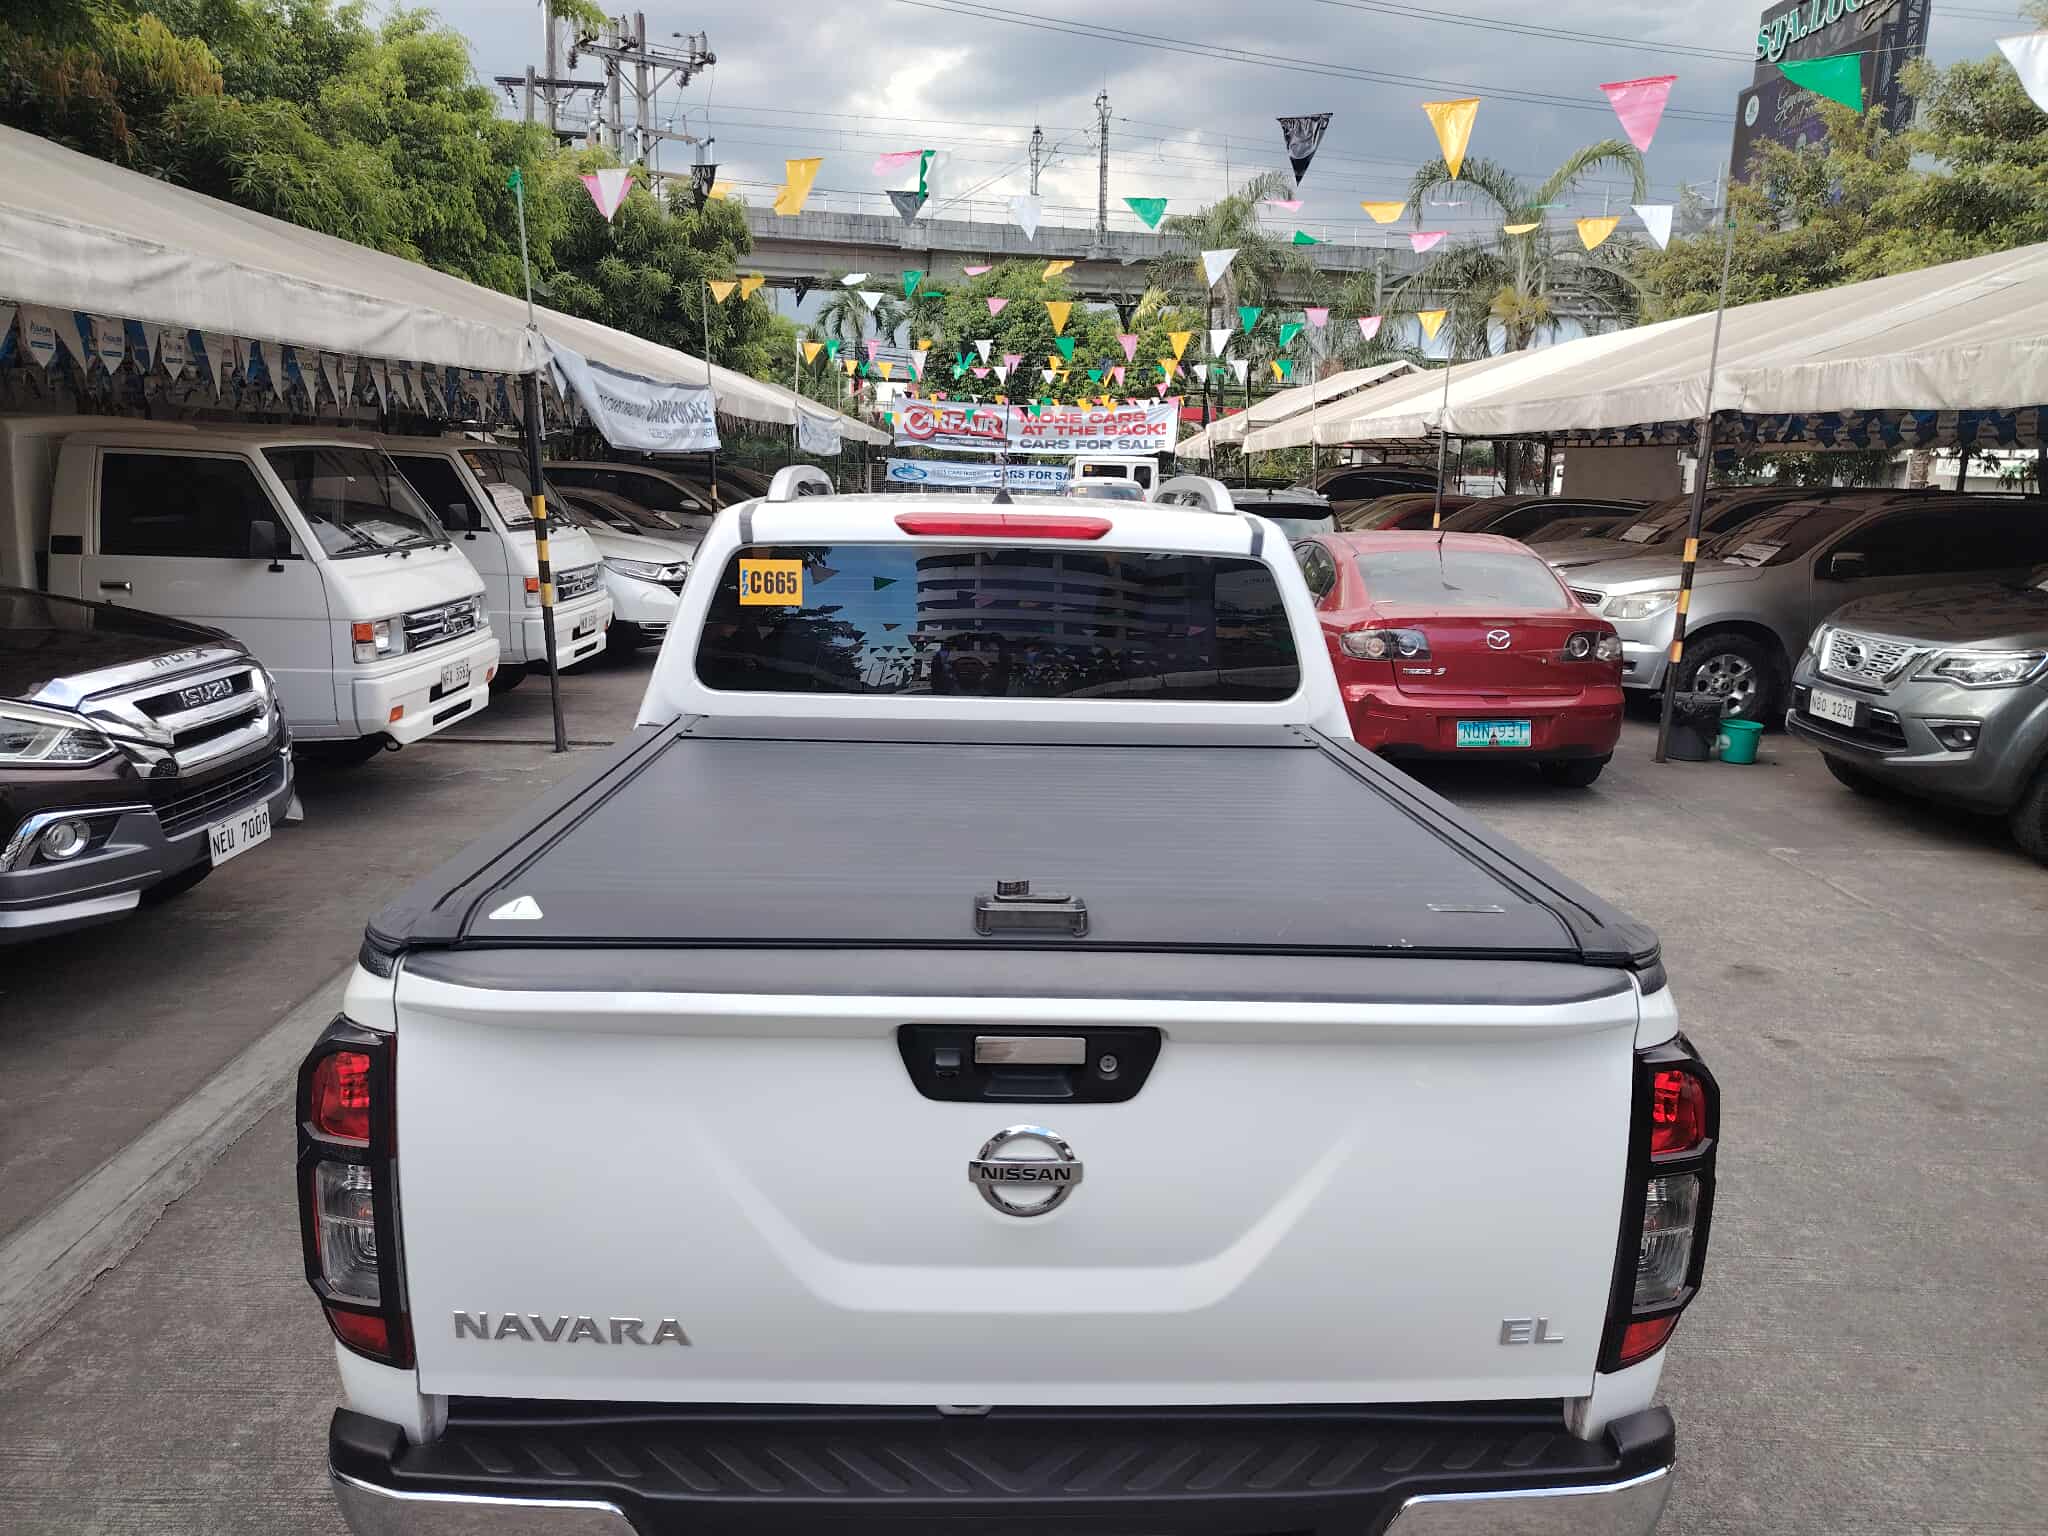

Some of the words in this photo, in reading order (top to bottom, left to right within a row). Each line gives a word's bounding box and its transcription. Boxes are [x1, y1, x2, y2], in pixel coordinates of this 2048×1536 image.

[904, 405, 1004, 439] CARFAIR
[1020, 412, 1082, 424] MORE
[1089, 412, 1147, 424] CARS
[1021, 425, 1047, 436] AT
[1054, 425, 1098, 436] THE
[1103, 422, 1167, 436] BACK!
[1020, 439, 1070, 450] CARS
[1076, 439, 1112, 450] FOR
[1118, 439, 1166, 450] SALE
[1028, 471, 1052, 480] FOR
[751, 570, 798, 595] C665
[180, 678, 234, 708] ISUZU
[211, 825, 236, 858] NEU
[241, 811, 269, 844] 7009
[980, 1166, 1072, 1182] NISSAN
[453, 1310, 693, 1347] NAVARA
[1500, 1317, 1565, 1345] EL
